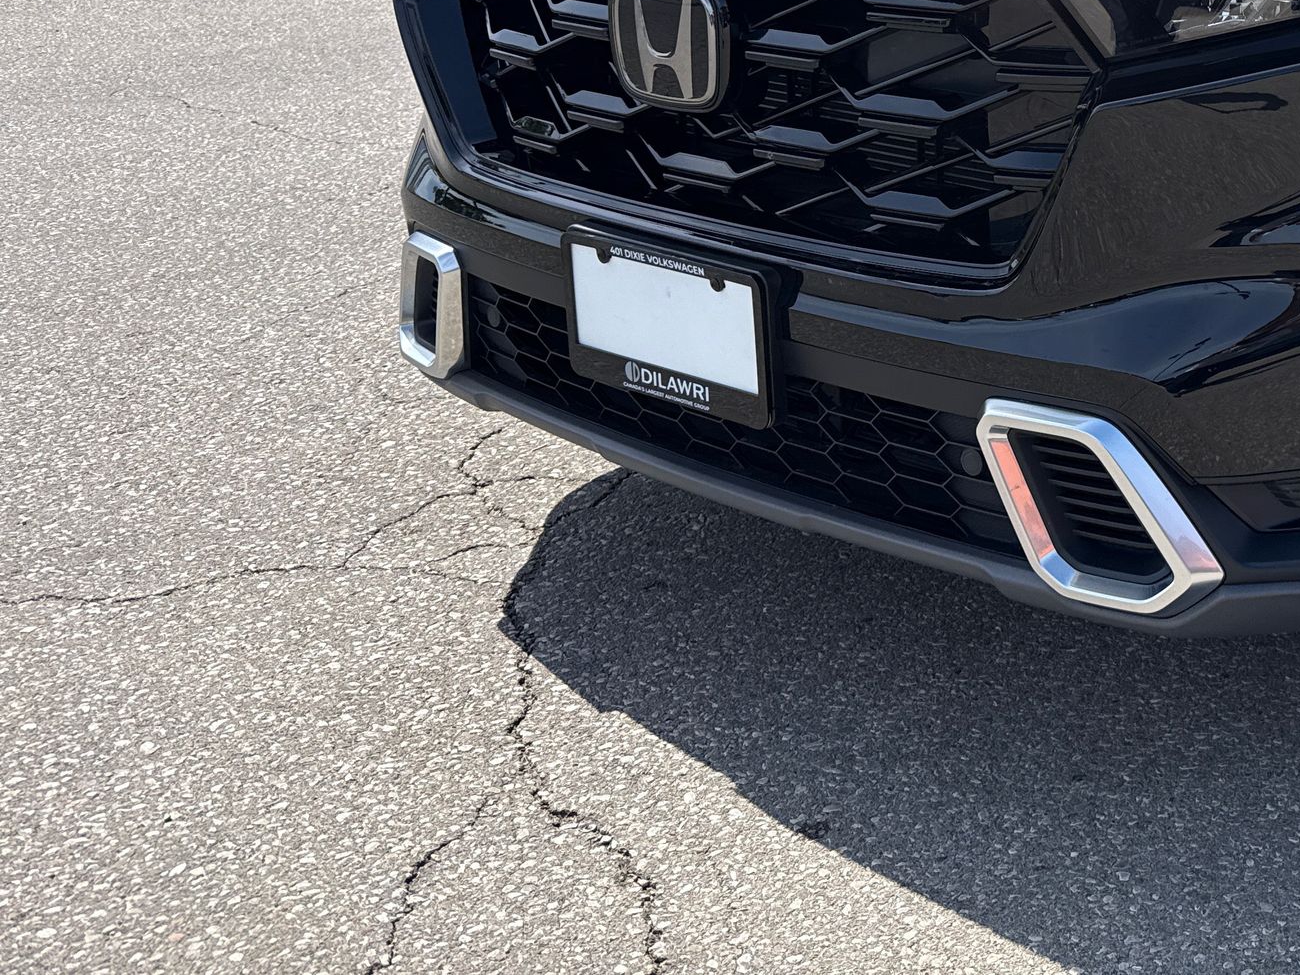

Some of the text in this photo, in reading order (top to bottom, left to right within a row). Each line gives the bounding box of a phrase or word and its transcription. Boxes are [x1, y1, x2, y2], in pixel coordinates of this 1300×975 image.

[609, 246, 705, 276] 401 DIXIE VOLKSWAGEN
[640, 368, 710, 402] DILAWRI
